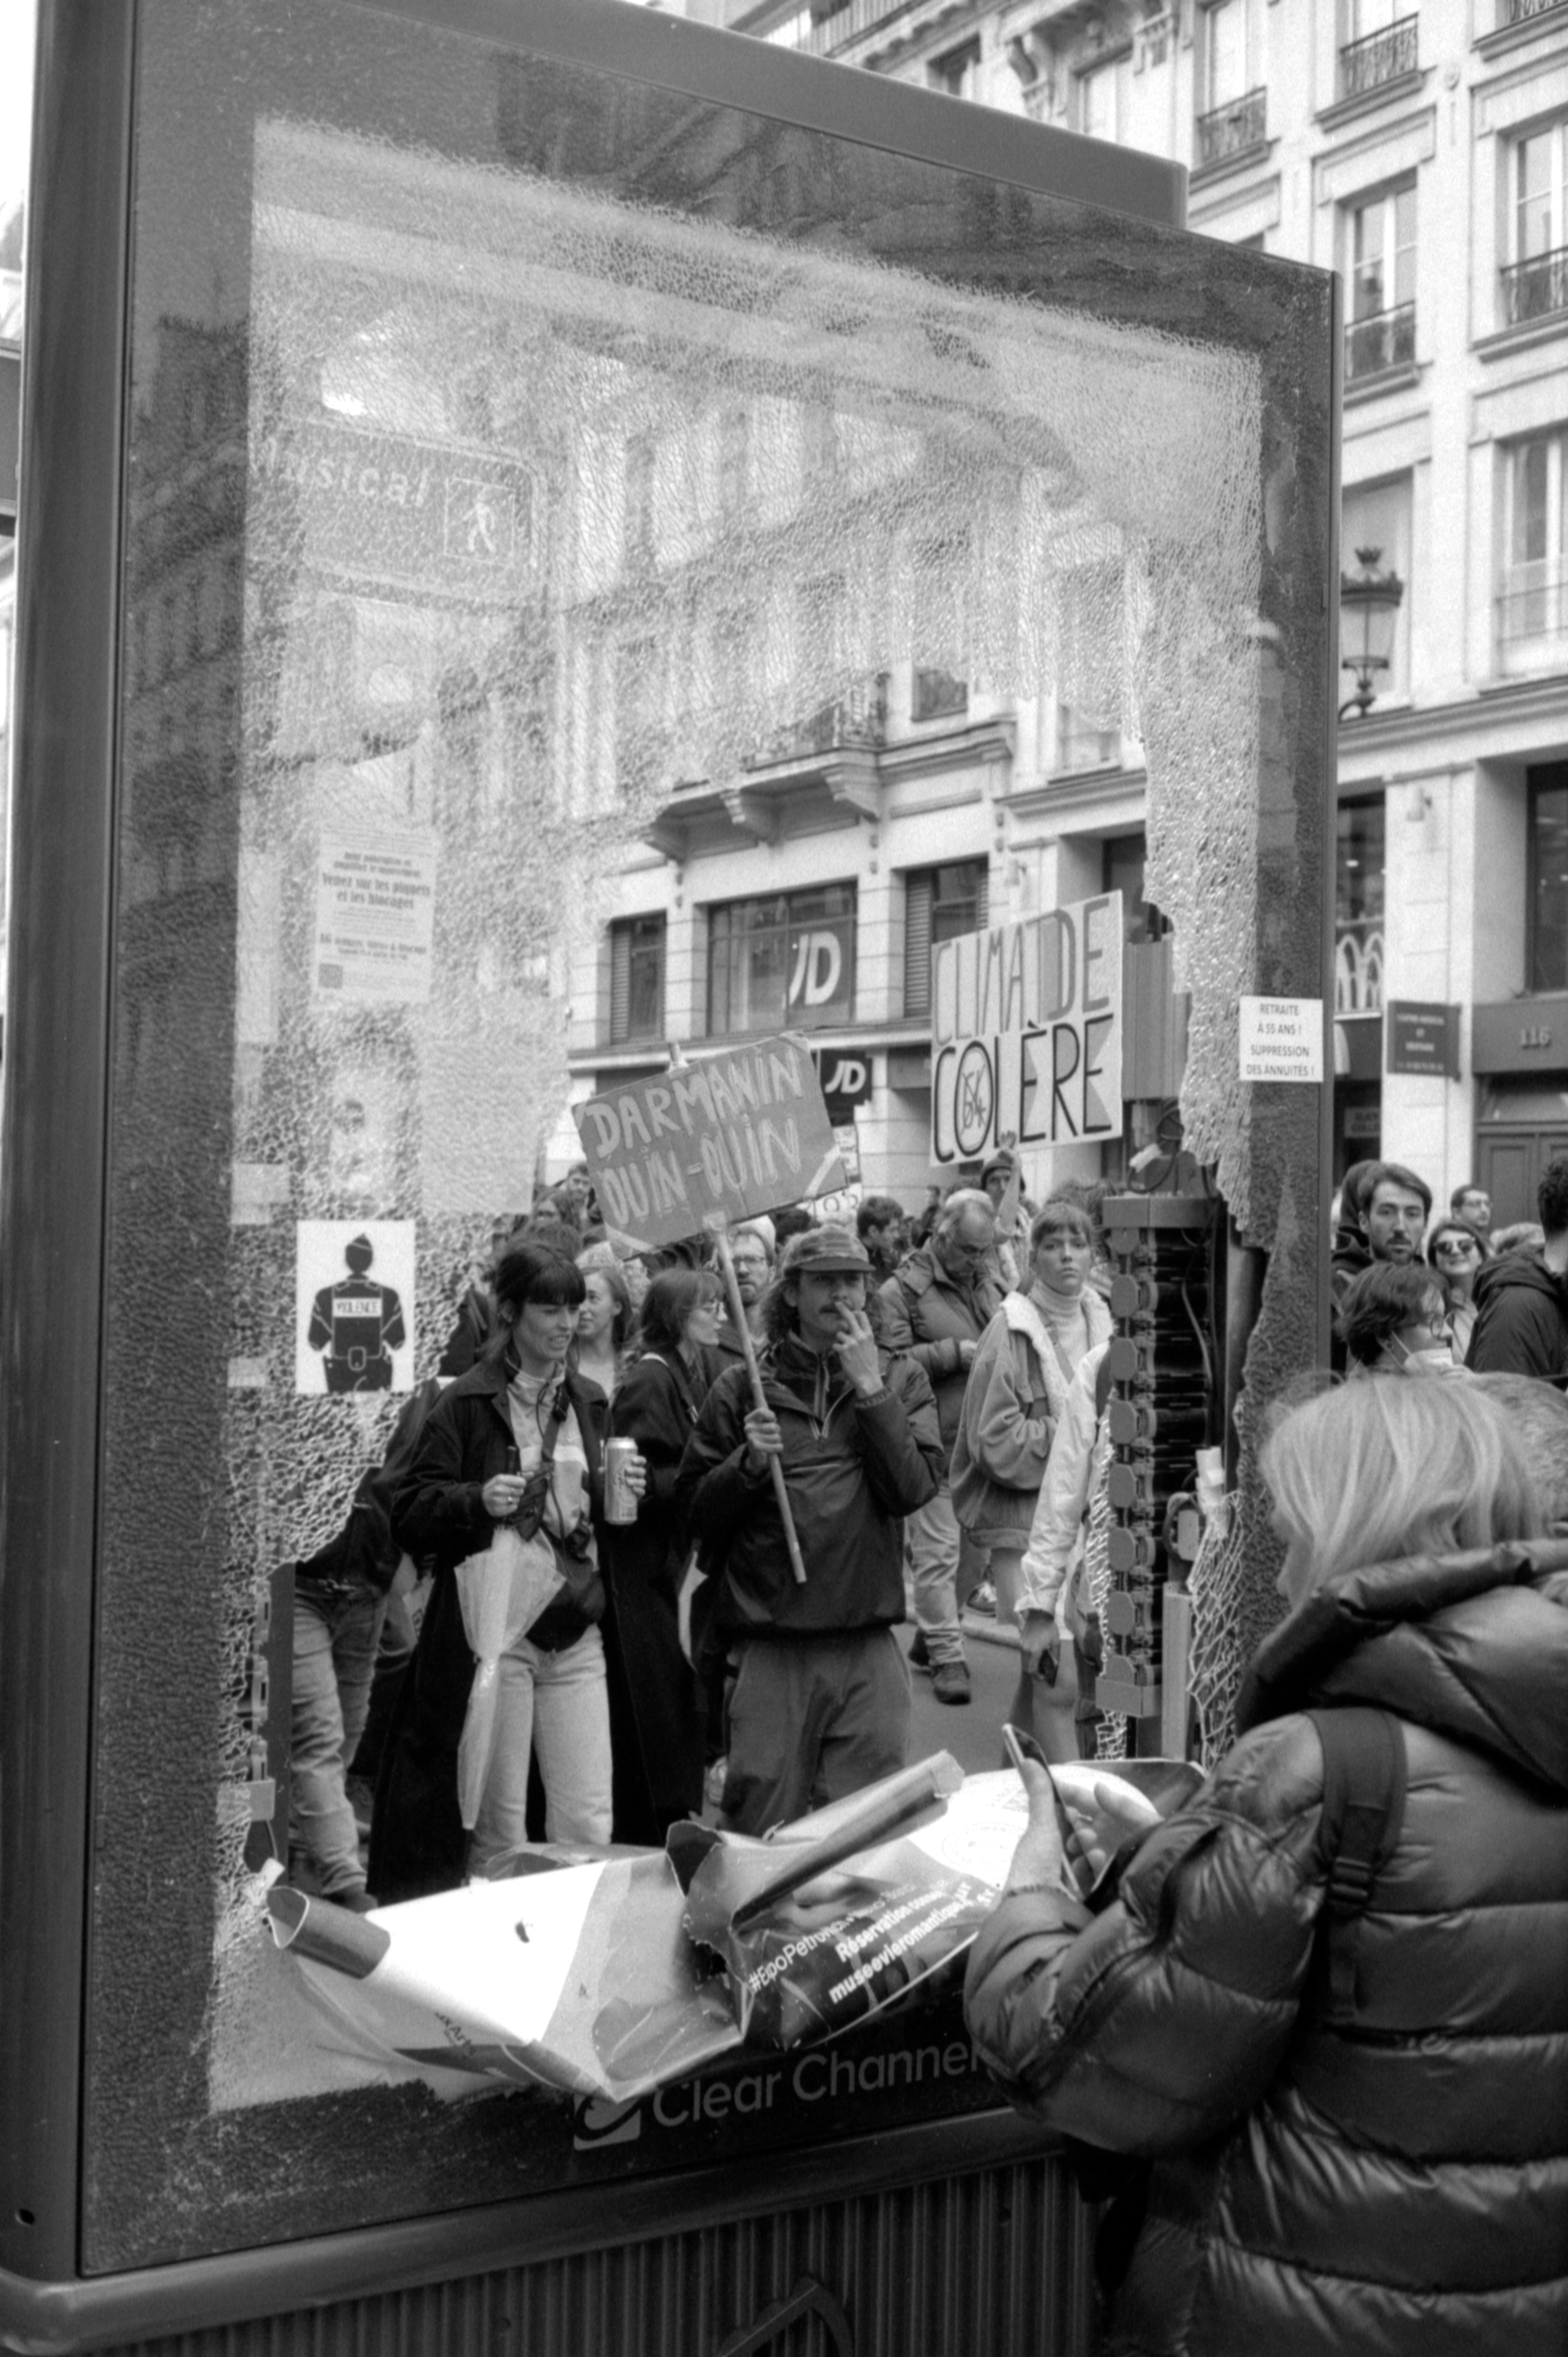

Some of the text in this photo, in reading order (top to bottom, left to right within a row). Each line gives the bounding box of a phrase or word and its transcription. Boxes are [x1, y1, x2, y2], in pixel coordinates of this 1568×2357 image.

[789, 931, 842, 1006] JD
[1259, 1003, 1299, 1017] RETRAITE
[1278, 1023, 1296, 1035] ANS
[1519, 1026, 1550, 1045] 116
[1251, 1044, 1309, 1057] SUPPRESSION
[824, 1060, 867, 1094] JD
[1246, 1063, 1262, 1075] DES
[1264, 1062, 1308, 1077] ANNUITÉS
[933, 1012, 1115, 1164] COLÈRE
[585, 1046, 805, 1160] DARMANIN
[337, 1301, 376, 1313] VIOLENCE
[835, 1906, 913, 1963] Réservation
[653, 2071, 781, 2127] Clear
